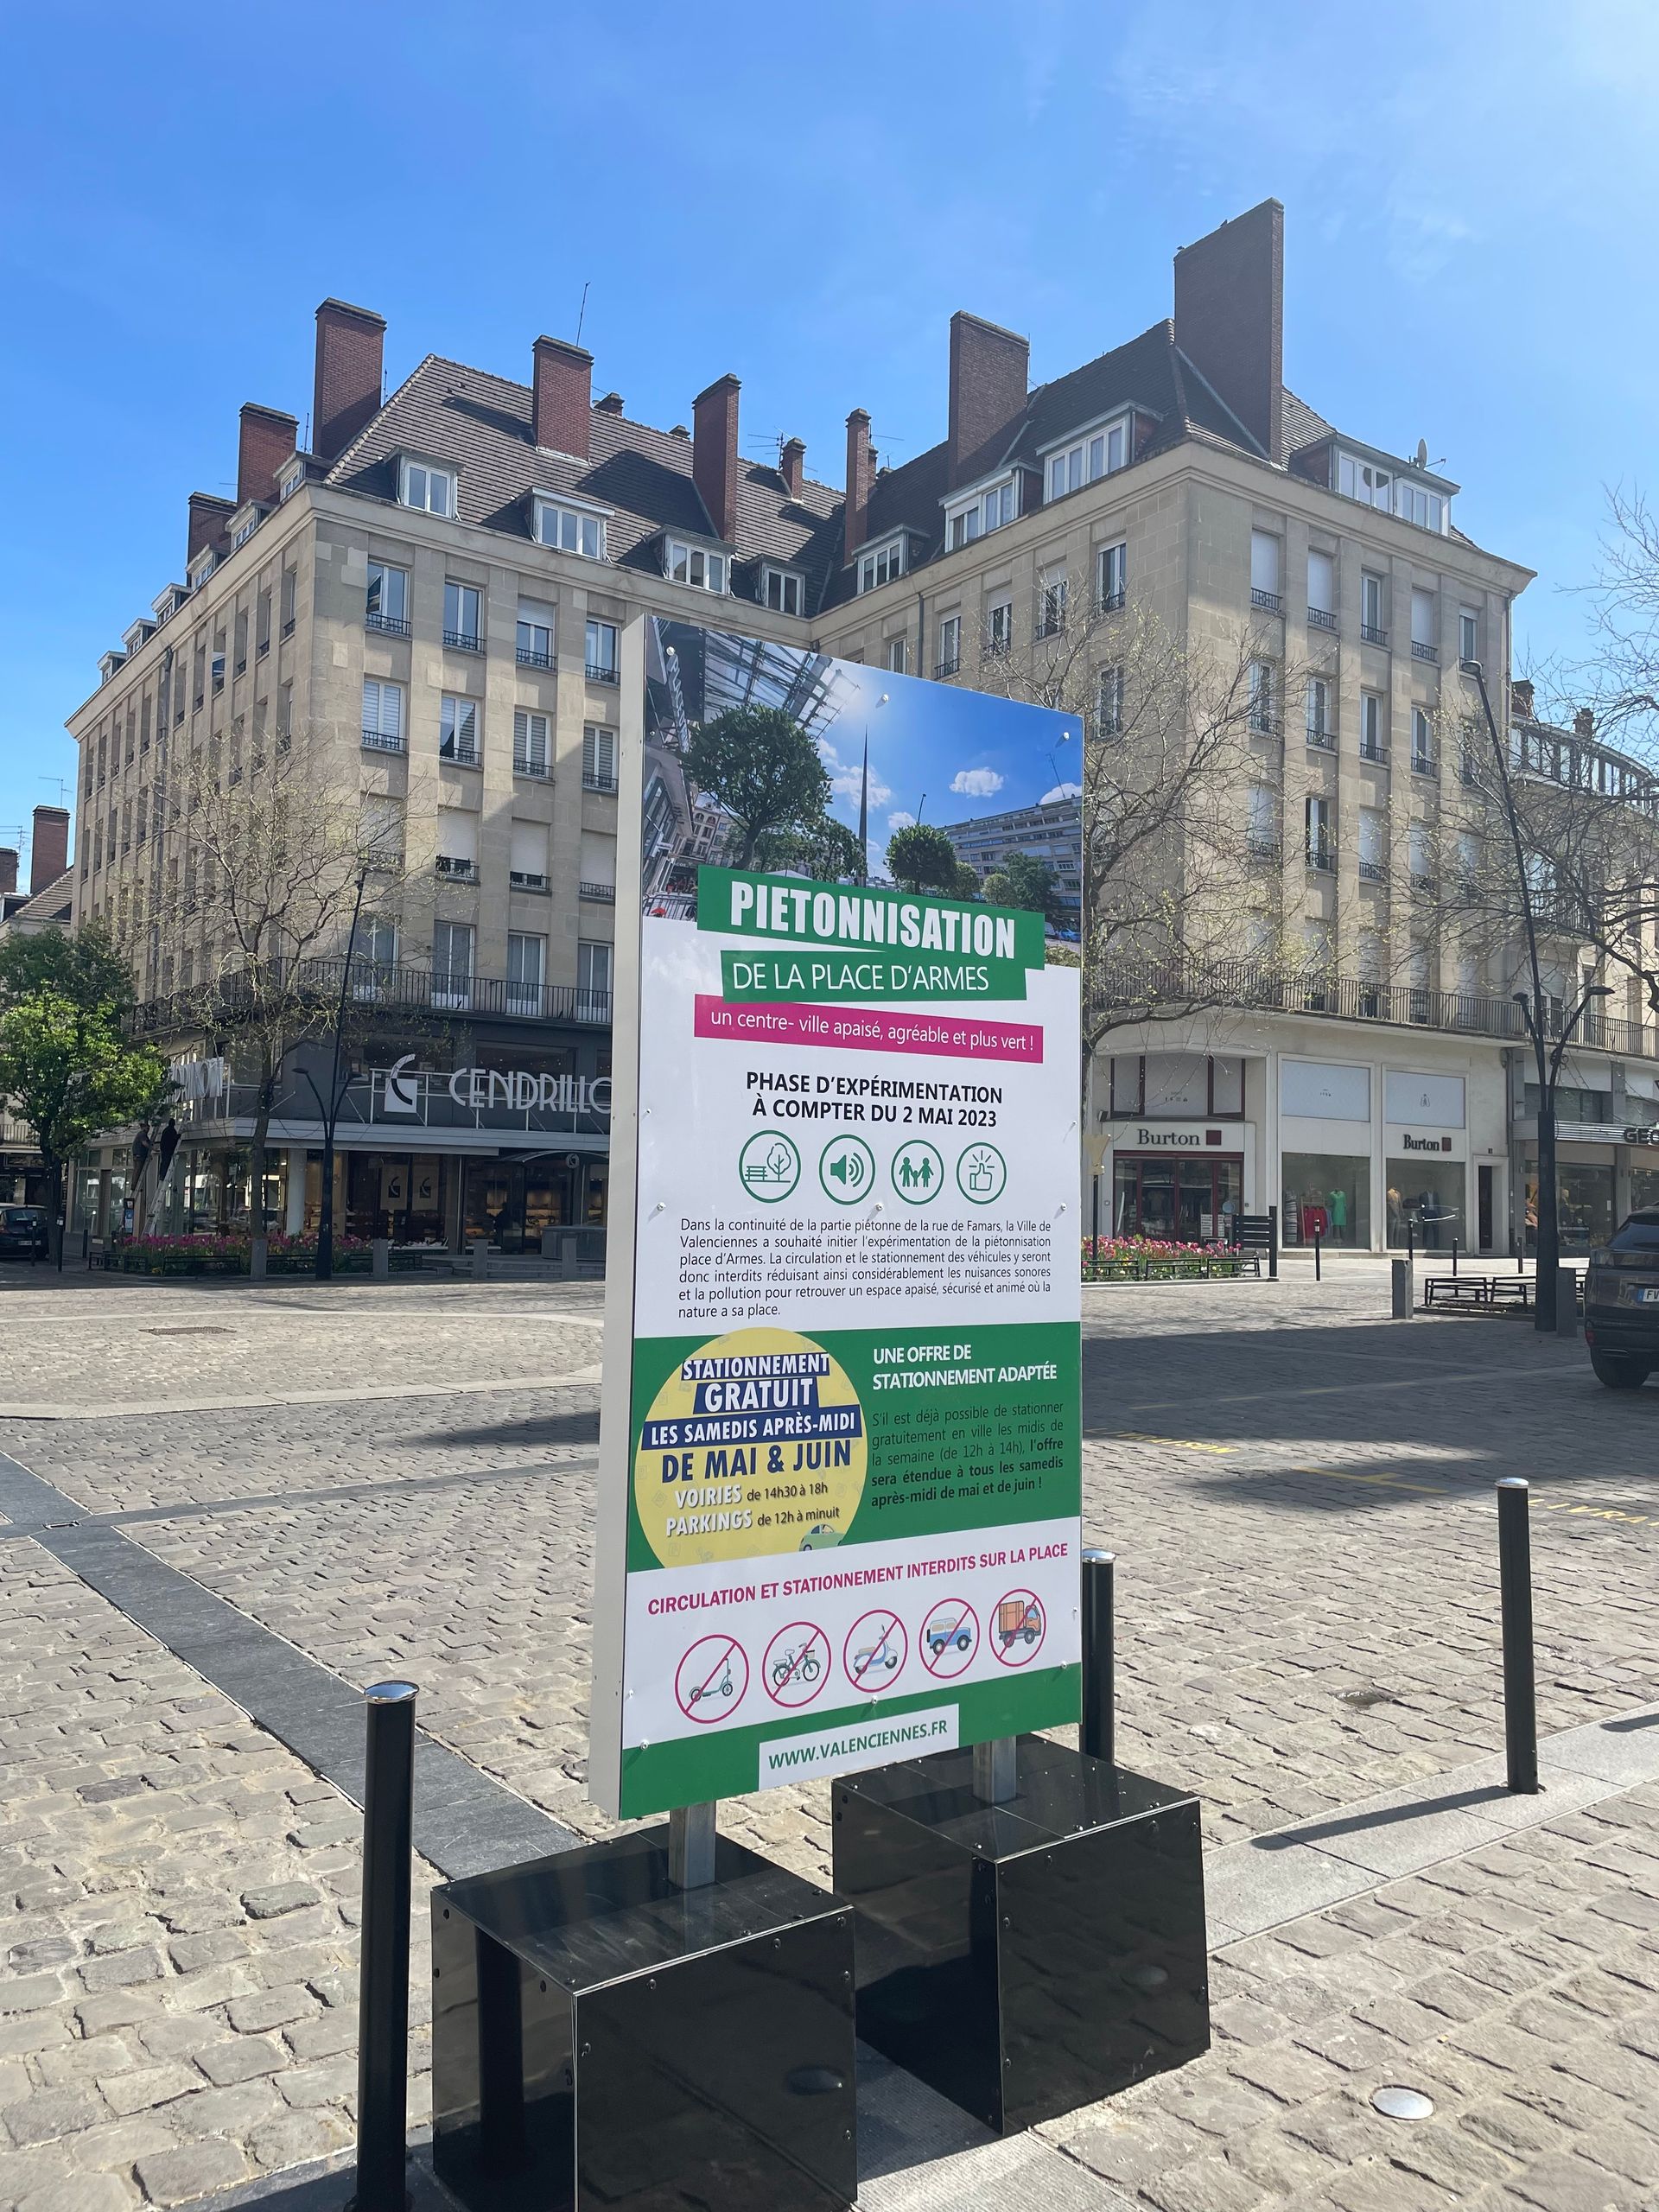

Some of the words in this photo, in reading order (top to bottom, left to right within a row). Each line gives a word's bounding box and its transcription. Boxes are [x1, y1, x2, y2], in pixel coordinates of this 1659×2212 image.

[731, 880, 1014, 959] PIETONNISATION
[734, 963, 766, 989] DE
[774, 963, 805, 990] LA
[812, 963, 884, 990] PLACE
[892, 965, 988, 991] D'ARMES
[711, 1012, 732, 1026] un
[737, 1009, 794, 1030] centre-
[799, 1015, 829, 1034] ville
[833, 1019, 883, 1043] apaisé,
[888, 1024, 948, 1044] agréable
[953, 1030, 966, 1046] et
[970, 1029, 997, 1050] plus
[1001, 1036, 1027, 1051] vert
[1030, 1035, 1033, 1051] !
[747, 1072, 810, 1092] PHASE
[817, 1074, 1002, 1103] D'EXPÉRIMENTATION
[753, 1093, 766, 1117] À
[772, 1100, 865, 1121] COMPTER
[871, 1105, 897, 1122] DU
[903, 1106, 912, 1123] 2
[918, 1109, 952, 1125] MAI
[958, 1109, 996, 1127] 2023
[1138, 1128, 1200, 1146] Burton
[1403, 1135, 1440, 1151] Burton
[681, 1218, 710, 1230] Dans
[715, 1218, 724, 1230] la
[728, 1218, 785, 1230] continuité
[790, 1219, 804, 1230] de
[808, 1219, 816, 1230] la
[821, 1219, 851, 1234] partie
[855, 1219, 900, 1234] piétonne
[905, 1219, 917, 1230] de
[920, 1220, 929, 1230] la
[932, 1223, 948, 1231] rue
[951, 1220, 963, 1231] de
[968, 1221, 1002, 1233] Famars,
[1006, 1220, 1014, 1231] la
[1017, 1221, 1036, 1231] Ville
[1039, 1221, 1051, 1231] de
[681, 1236, 757, 1248] Valenciennes
[763, 1238, 769, 1247] a
[775, 1236, 822, 1247] souhaité
[828, 1236, 857, 1247] initier
[863, 1236, 950, 1249] l'expérimentation
[956, 1236, 967, 1246] de
[972, 1236, 980, 1246] la
[985, 1236, 1051, 1249] piétonnisation
[680, 1253, 711, 1268] place
[715, 1253, 766, 1264] d'Armes.
[770, 1253, 781, 1264] La
[785, 1252, 842, 1263] circulation
[846, 1254, 855, 1263] et
[860, 1252, 868, 1262] le
[872, 1252, 944, 1262] stationnement
[948, 1252, 964, 1262] des
[968, 1251, 1011, 1262] véhicules
[1014, 1254, 1019, 1264] y
[1022, 1252, 1051, 1262] seront
[679, 1270, 709, 1282] donc
[715, 1270, 762, 1281] interdits
[767, 1269, 818, 1281] réduisant
[823, 1268, 848, 1280] ainsi
[852, 1268, 944, 1280] considérablement
[948, 1268, 961, 1278] les
[965, 1268, 1011, 1277] nuisances
[1015, 1268, 1050, 1277] sonores
[679, 1290, 690, 1300] et
[695, 1287, 704, 1300] la
[709, 1287, 761, 1302] pollution
[766, 1288, 791, 1301] pour
[796, 1287, 845, 1297] retrouver
[849, 1286, 862, 1295] un
[867, 1285, 901, 1298] espace
[906, 1283, 938, 1297] apaisé,
[943, 1283, 981, 1294] sécurisé
[984, 1283, 993, 1293] et
[996, 1281, 1025, 1292] animé
[1028, 1281, 1039, 1292] où
[1043, 1281, 1050, 1292] la
[679, 1306, 717, 1318] nature
[721, 1308, 728, 1317] a
[732, 1307, 743, 1316] sa
[748, 1304, 780, 1319] place.
[683, 1354, 829, 1380] STATIONNEMENT
[874, 1348, 905, 1364] UNE
[907, 1345, 950, 1362] OFFRE
[954, 1344, 971, 1360] DE
[873, 1368, 995, 1389] STATIONNEMENT
[998, 1361, 1057, 1382] ADAPTÉE
[705, 1379, 813, 1412] GRATUIT
[652, 1426, 677, 1445] LES
[685, 1420, 757, 1442] SAMEDIS
[763, 1412, 854, 1436] APRÈS-MIDI
[873, 1413, 888, 1427] S'il
[894, 1413, 910, 1424] est
[916, 1410, 939, 1426] déjà
[945, 1407, 988, 1424] possible
[995, 1405, 1007, 1417] de
[1013, 1403, 1063, 1415] stationner
[872, 1428, 945, 1450] gratuitement
[952, 1429, 965, 1439] en
[971, 1426, 992, 1438] ville
[998, 1423, 1012, 1435] les
[1018, 1421, 1045, 1433] midis
[1051, 1421, 1063, 1431] de
[662, 1453, 693, 1483] DE
[705, 1448, 756, 1478] MAI
[767, 1445, 784, 1473] &
[793, 1440, 850, 1471] JUIN
[872, 1453, 881, 1465] la
[887, 1449, 934, 1465] semaine
[940, 1447, 957, 1462] (de
[963, 1445, 982, 1458] 12h
[988, 1443, 994, 1455] à
[1000, 1441, 1025, 1455] 14h),
[1030, 1439, 1063, 1452] l'offre
[872, 1472, 896, 1486] sera
[903, 1468, 951, 1484] étendue
[957, 1466, 963, 1478] à
[969, 1465, 994, 1477] tous
[1000, 1461, 1014, 1473] les
[1020, 1457, 1063, 1471] samedis
[675, 1485, 742, 1509] VOIRIES
[747, 1490, 760, 1501] de
[765, 1485, 797, 1498] 14h30
[800, 1484, 805, 1496] à
[810, 1483, 828, 1495] 18h
[872, 1487, 936, 1510] après-midi
[941, 1486, 954, 1498] de
[958, 1484, 979, 1497] mai
[983, 1484, 993, 1494] et
[998, 1480, 1011, 1492] de
[1014, 1479, 1035, 1495] juin
[1039, 1477, 1041, 1488] !
[666, 1510, 752, 1536] PARKINGS
[758, 1515, 771, 1526] de
[775, 1511, 793, 1524] 12h
[797, 1510, 803, 1521] à
[806, 1507, 839, 1520] minuit
[648, 1586, 755, 1615] CIRCULATION
[761, 1582, 779, 1599] ET
[783, 1566, 902, 1597] STATIONNEMENT
[906, 1556, 976, 1580] INTERDITS
[979, 1553, 1007, 1567] SUR
[1010, 1549, 1026, 1564] LA
[1029, 1543, 1068, 1560] PLACE
[768, 1720, 947, 1770] WWW.VALENCIENNES.FR
